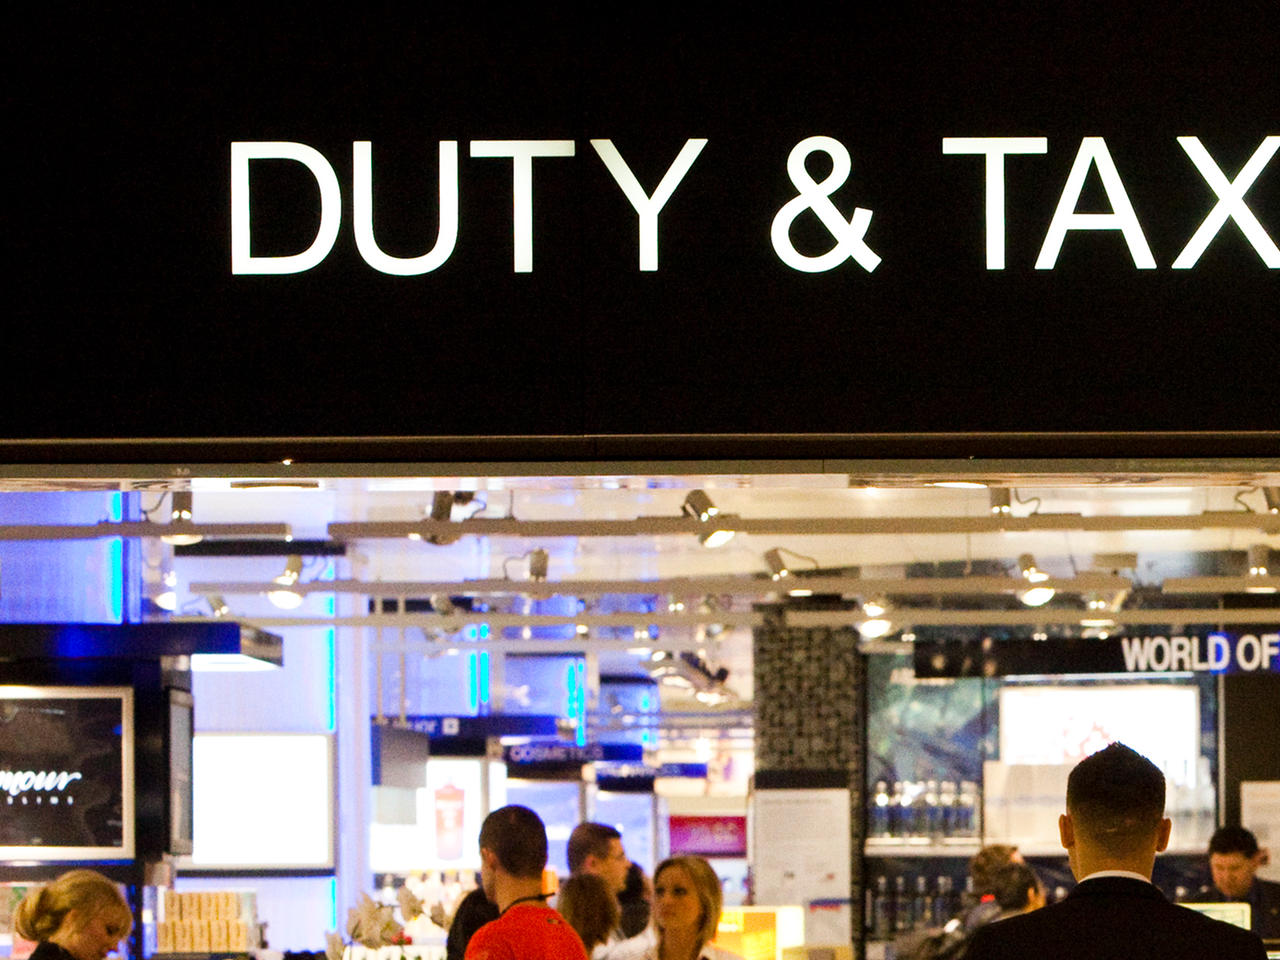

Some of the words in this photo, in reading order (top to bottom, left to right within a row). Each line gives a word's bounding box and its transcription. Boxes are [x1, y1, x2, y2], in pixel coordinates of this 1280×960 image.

[229, 138, 709, 277] DUTY
[770, 135, 883, 274] &
[1121, 633, 1231, 672] WORLD
[1236, 633, 1280, 671] OF
